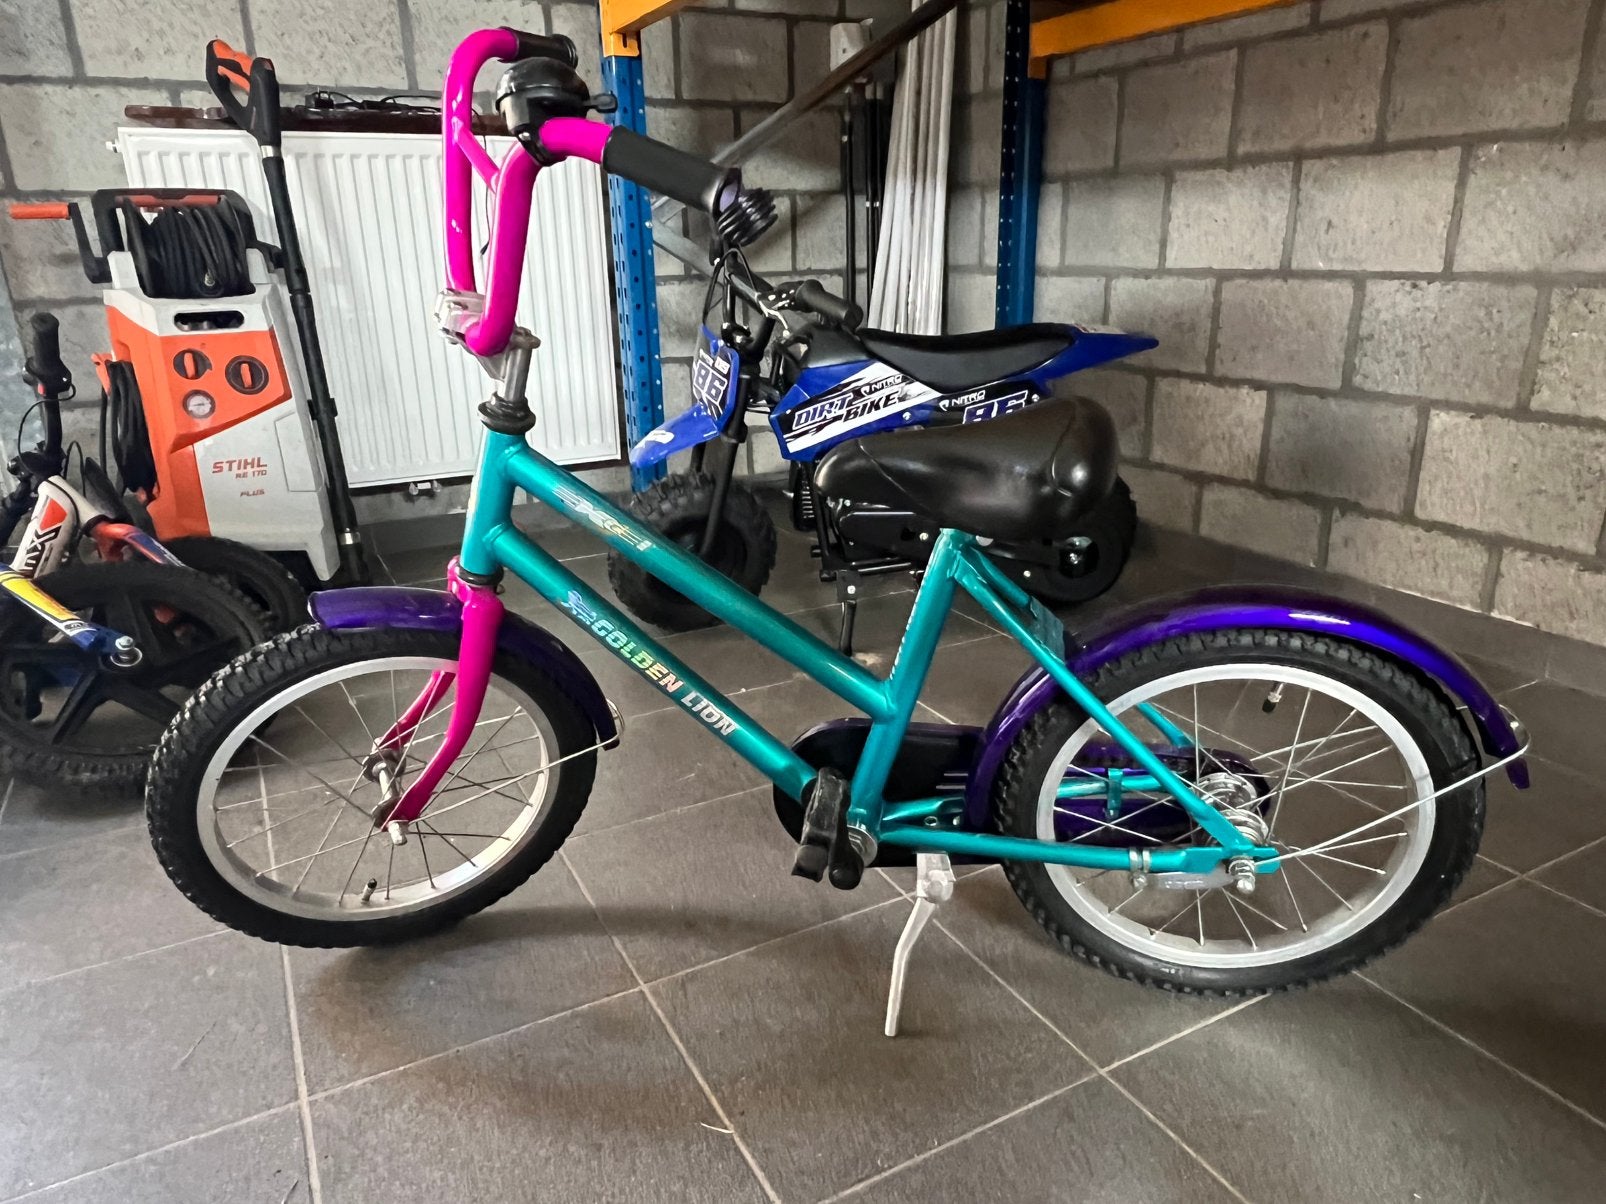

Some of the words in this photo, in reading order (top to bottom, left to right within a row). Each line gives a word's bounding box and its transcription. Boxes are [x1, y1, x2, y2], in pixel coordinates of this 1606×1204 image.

[694, 360, 728, 404] 86
[793, 393, 853, 430] DIRT
[843, 391, 899, 422] BIKE
[212, 457, 268, 474] STIHL
[240, 489, 265, 497] PLUS
[591, 619, 684, 693] GOLDEN
[681, 690, 740, 736] LION
